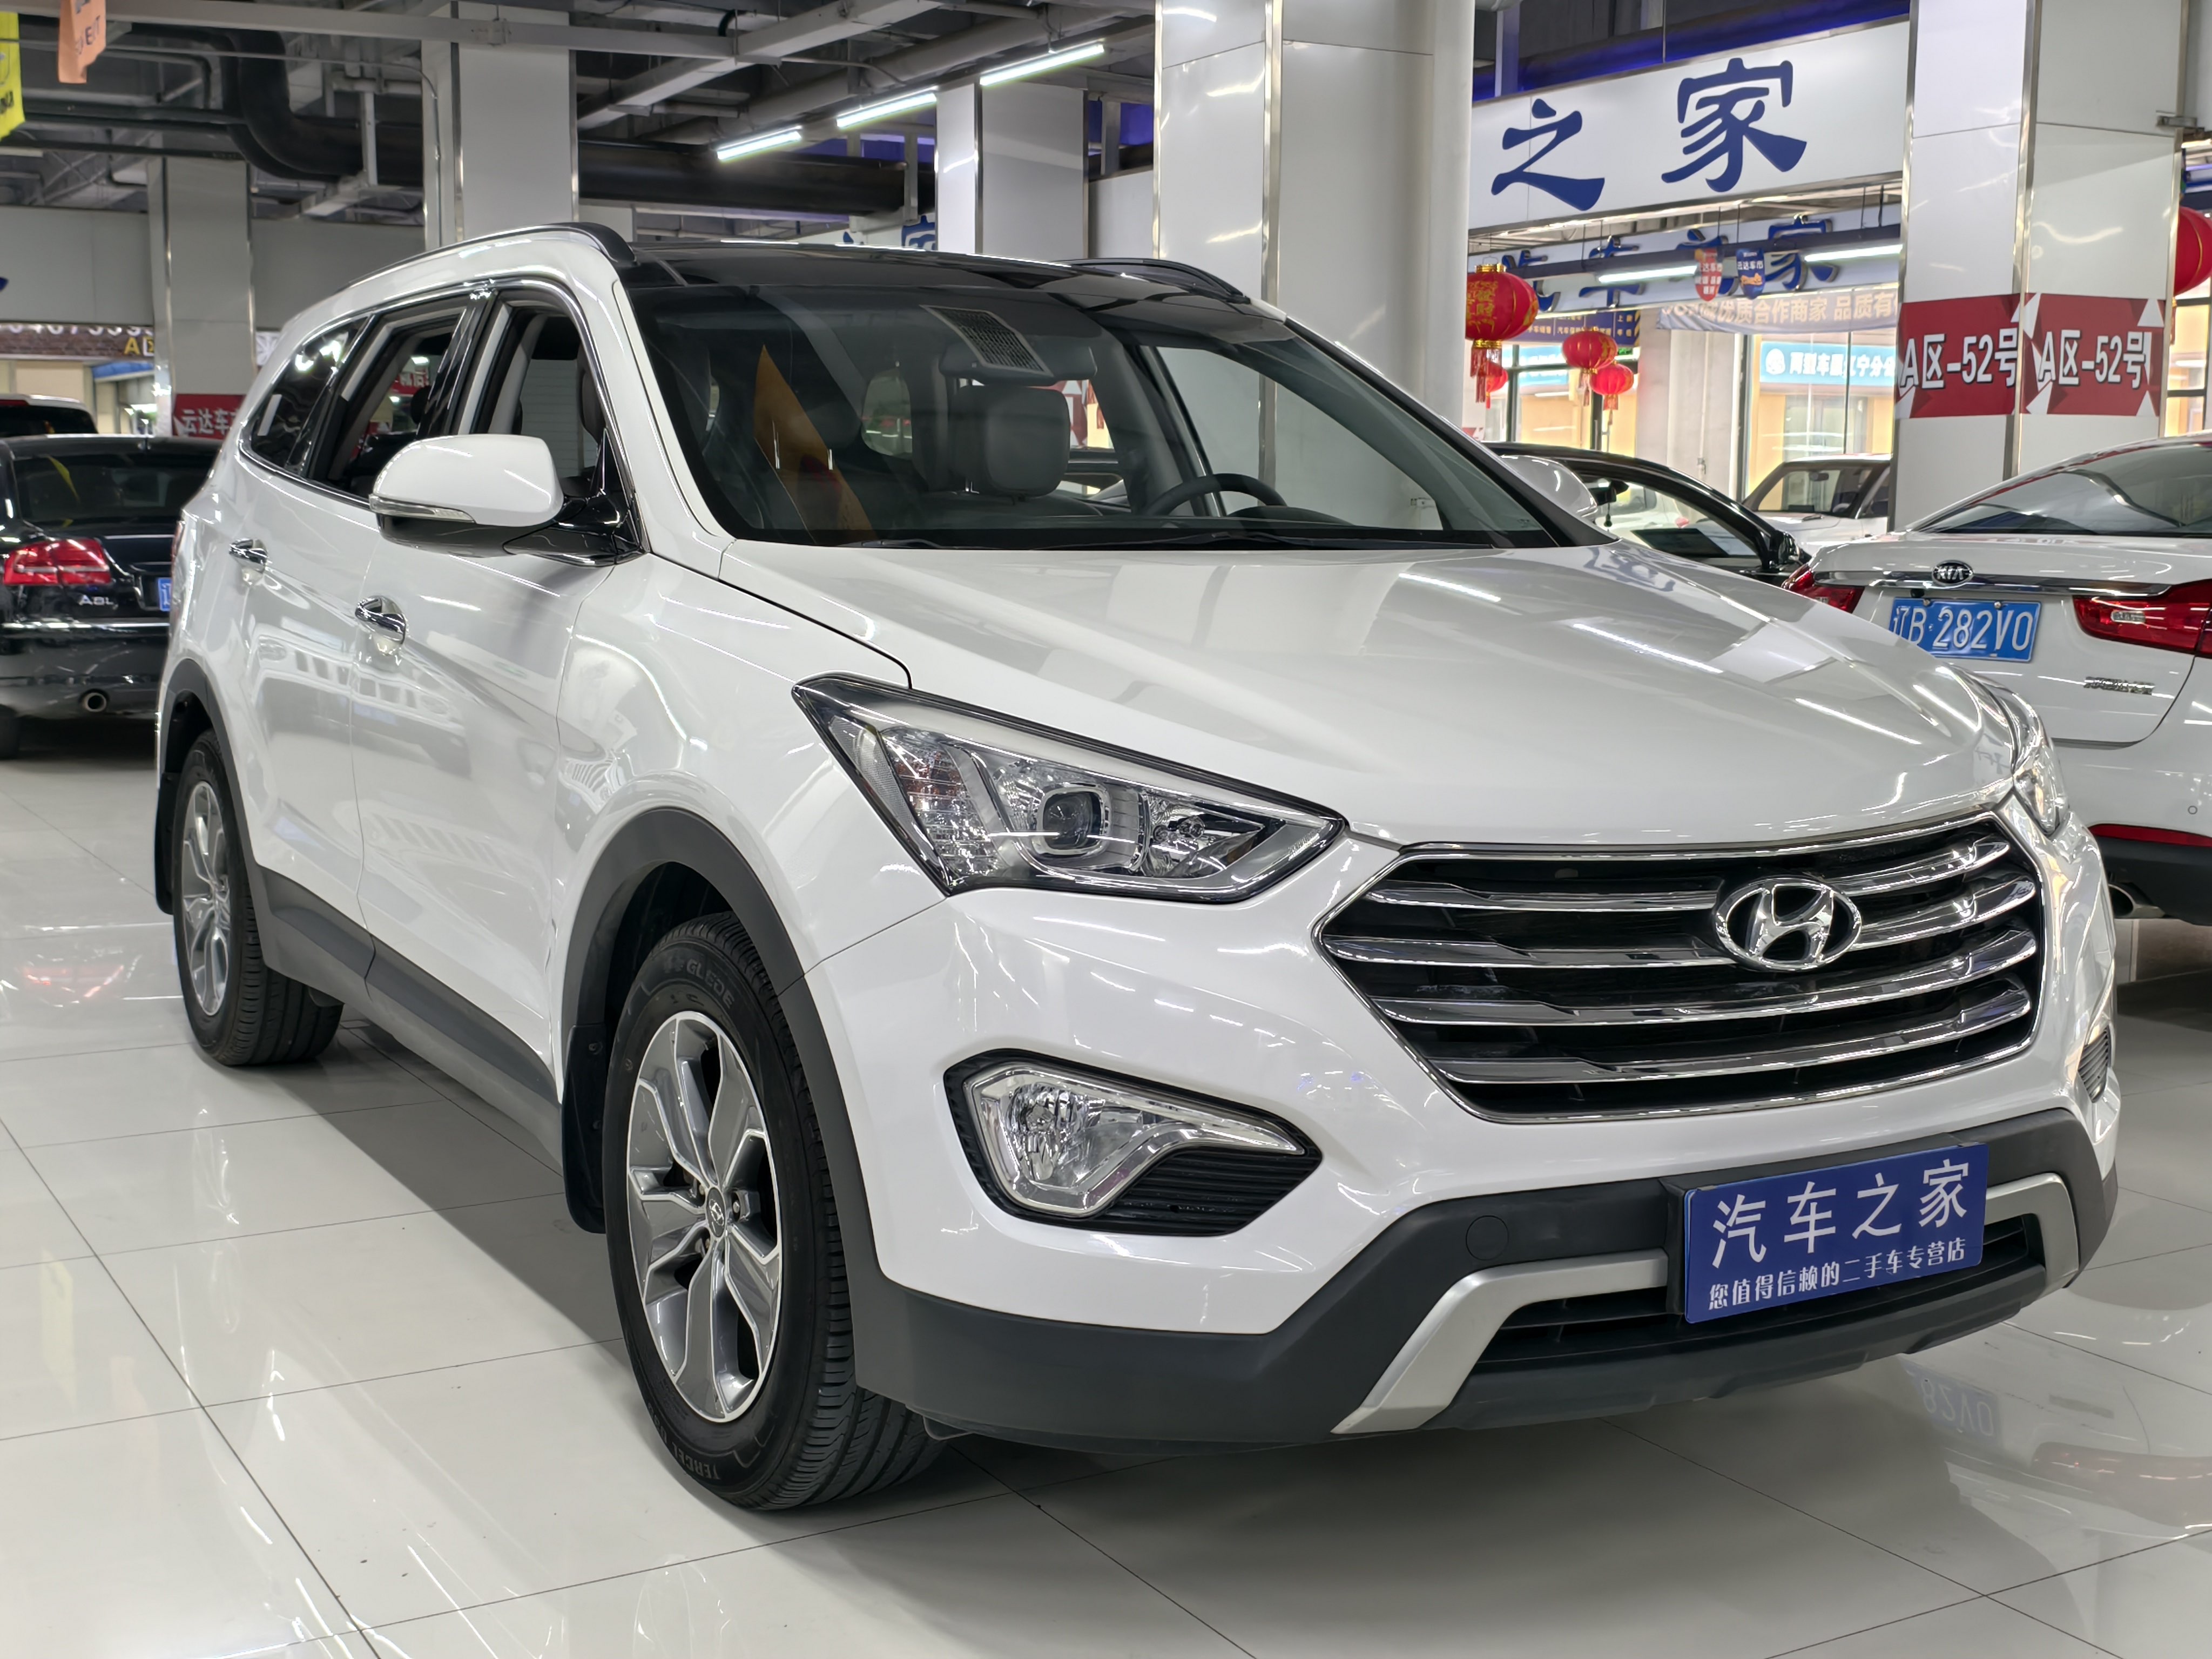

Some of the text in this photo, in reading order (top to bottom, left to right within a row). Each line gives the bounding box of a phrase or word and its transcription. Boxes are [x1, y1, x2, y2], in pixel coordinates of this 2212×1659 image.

[1491, 58, 1807, 211] 之家
[1835, 292, 1897, 321] 品质有
[1900, 328, 2018, 388] A区-52号
[2038, 329, 2145, 389] A区-52号
[1711, 1158, 1969, 1269] 汽车之家
[1708, 1237, 1966, 1310] 您值得信赖的二手车专营店
